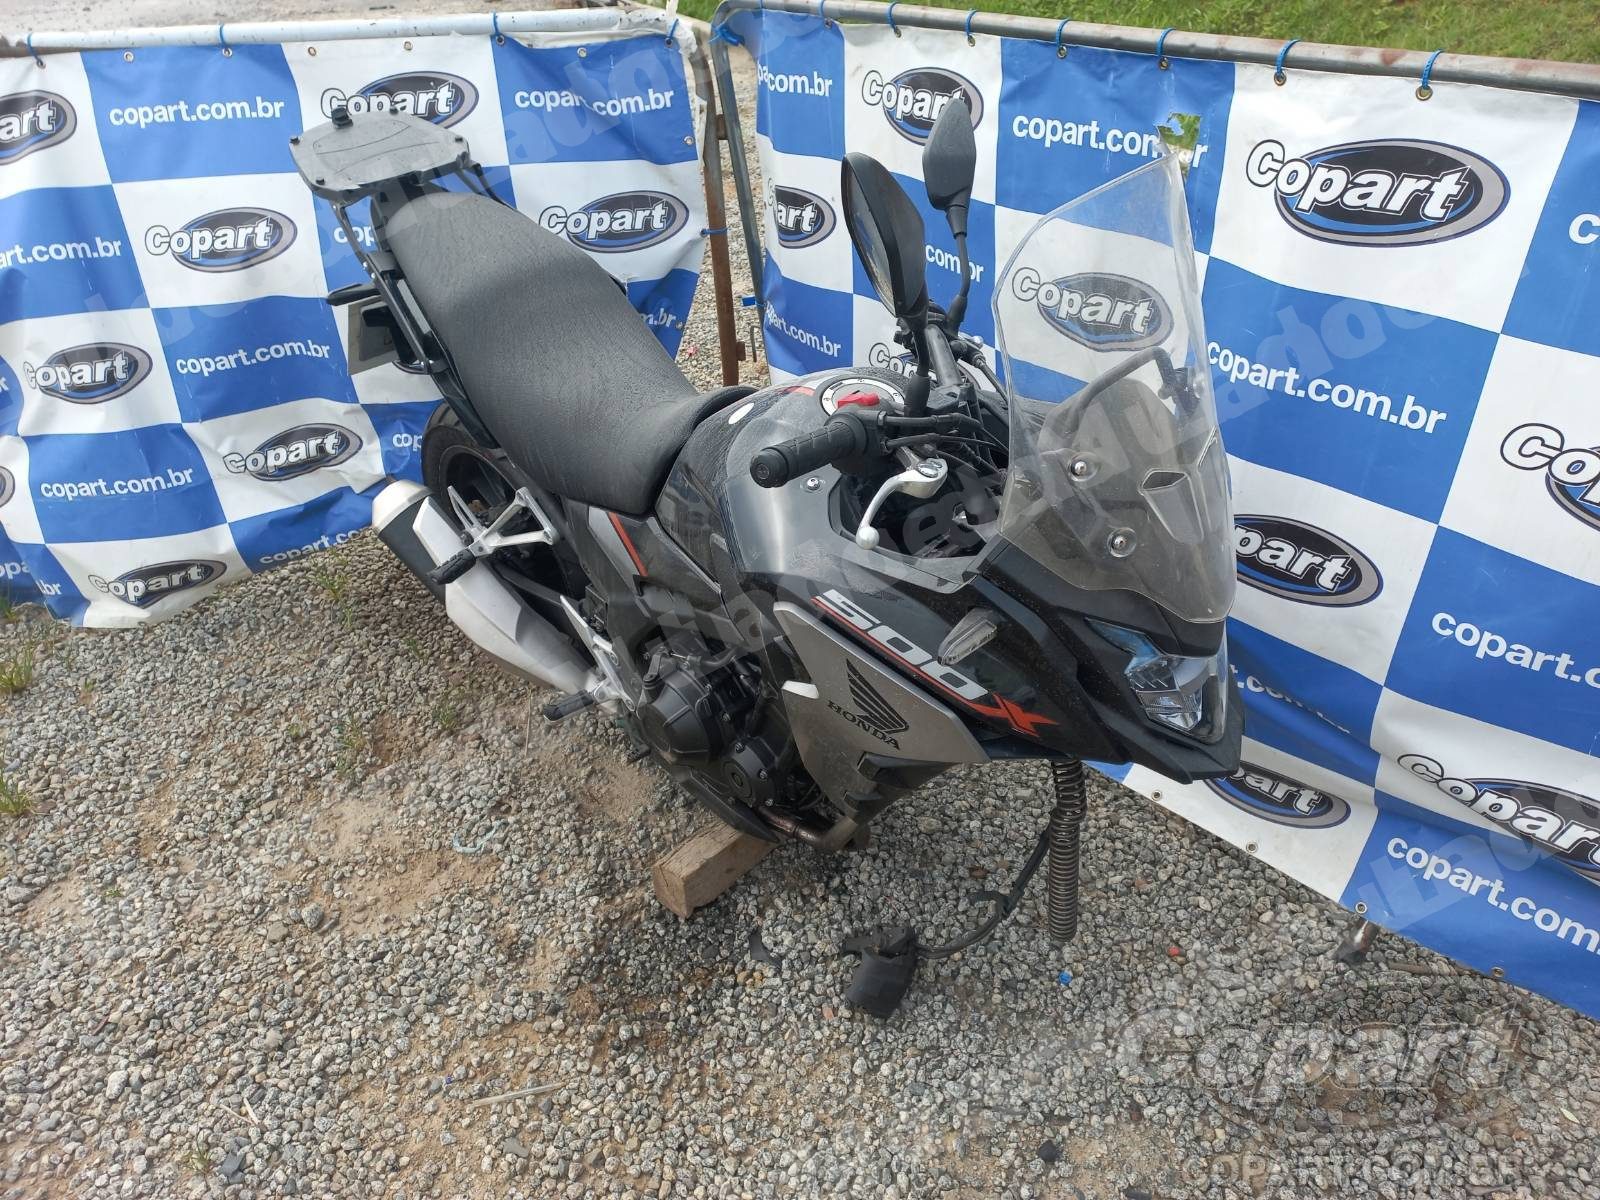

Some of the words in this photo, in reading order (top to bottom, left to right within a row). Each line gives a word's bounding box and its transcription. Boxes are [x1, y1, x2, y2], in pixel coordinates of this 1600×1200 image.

[109, 97, 285, 128] copart.com.br
[862, 70, 965, 122] Copar
[1246, 139, 1472, 222] Copart
[145, 217, 272, 259] Copart
[539, 200, 668, 241] Copart
[1012, 267, 1155, 337] Copart
[23, 351, 129, 393] Copart
[176, 340, 330, 376] copart.com.br
[1207, 341, 1448, 434] copart.com.br
[223, 430, 342, 474] Copart
[40, 467, 193, 500] copart.com.br
[88, 562, 206, 602] Copart
[827, 700, 900, 750] HONDA
[1397, 753, 1600, 868] Copar
